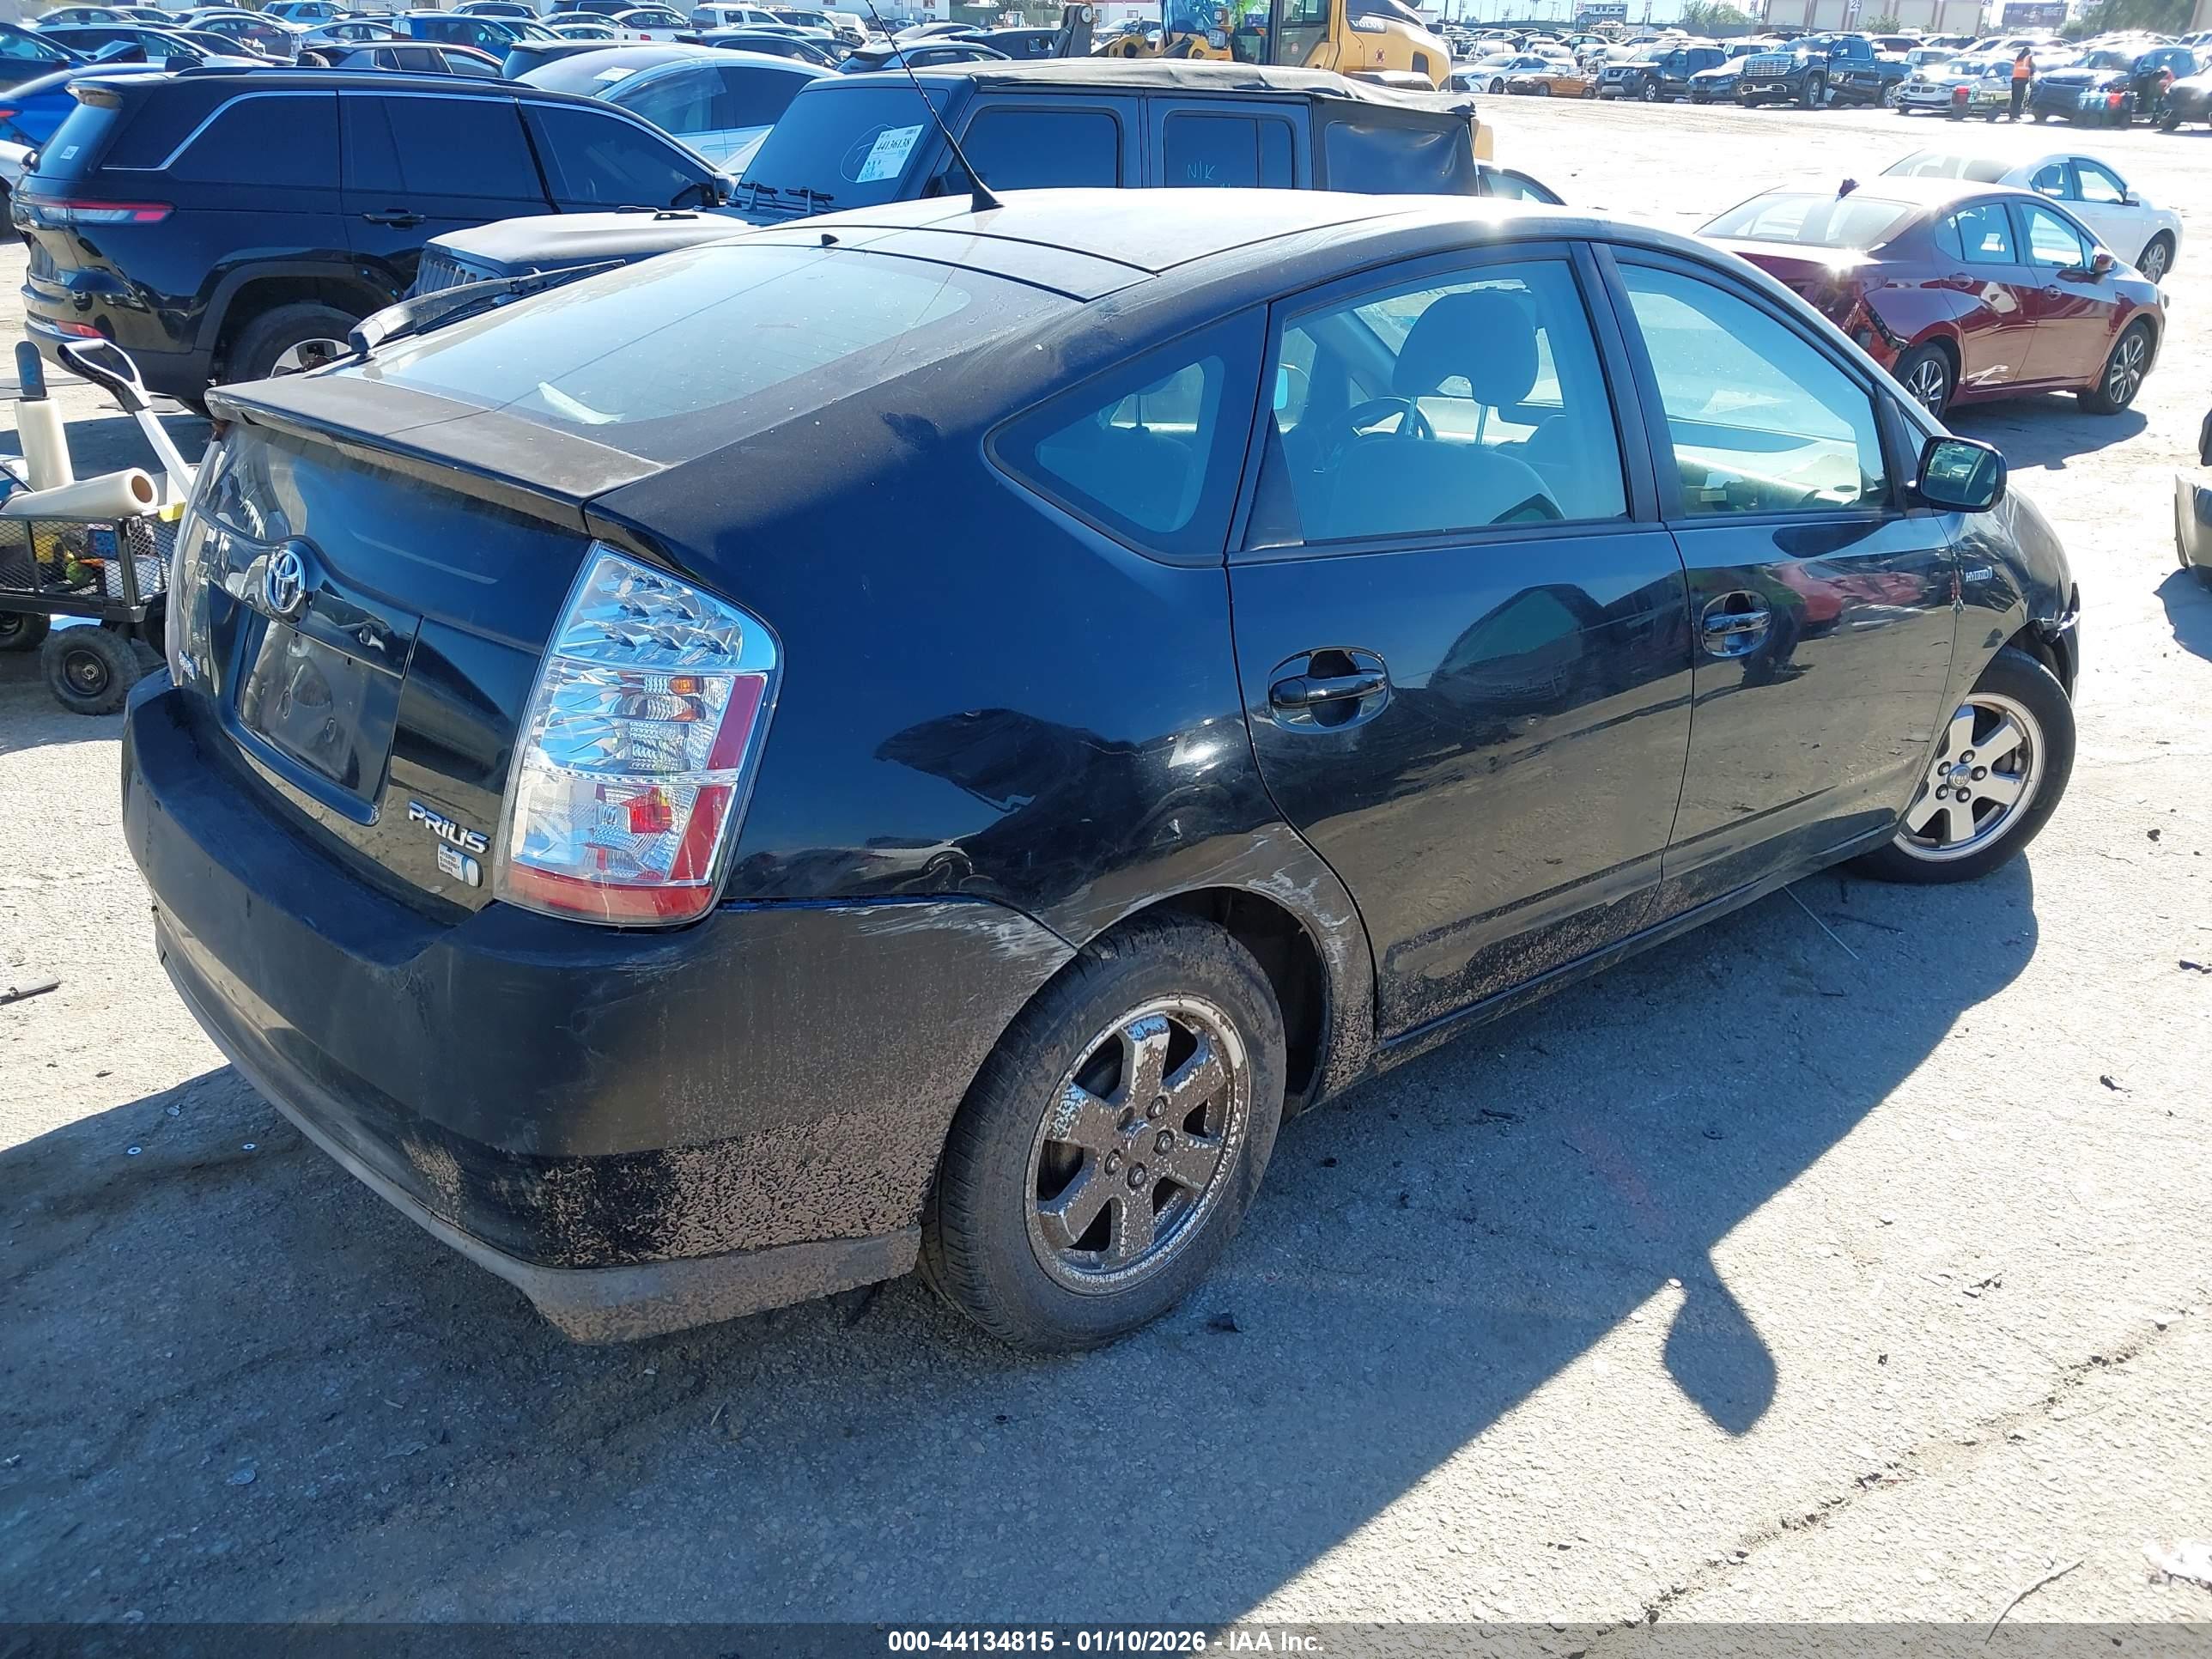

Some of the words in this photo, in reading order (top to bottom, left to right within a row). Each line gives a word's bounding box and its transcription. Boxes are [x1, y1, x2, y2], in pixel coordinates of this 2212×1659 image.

[1350, 20, 1384, 29] VOLVO
[1965, 568, 1989, 581] HYBRID
[409, 800, 490, 854] PRIUS
